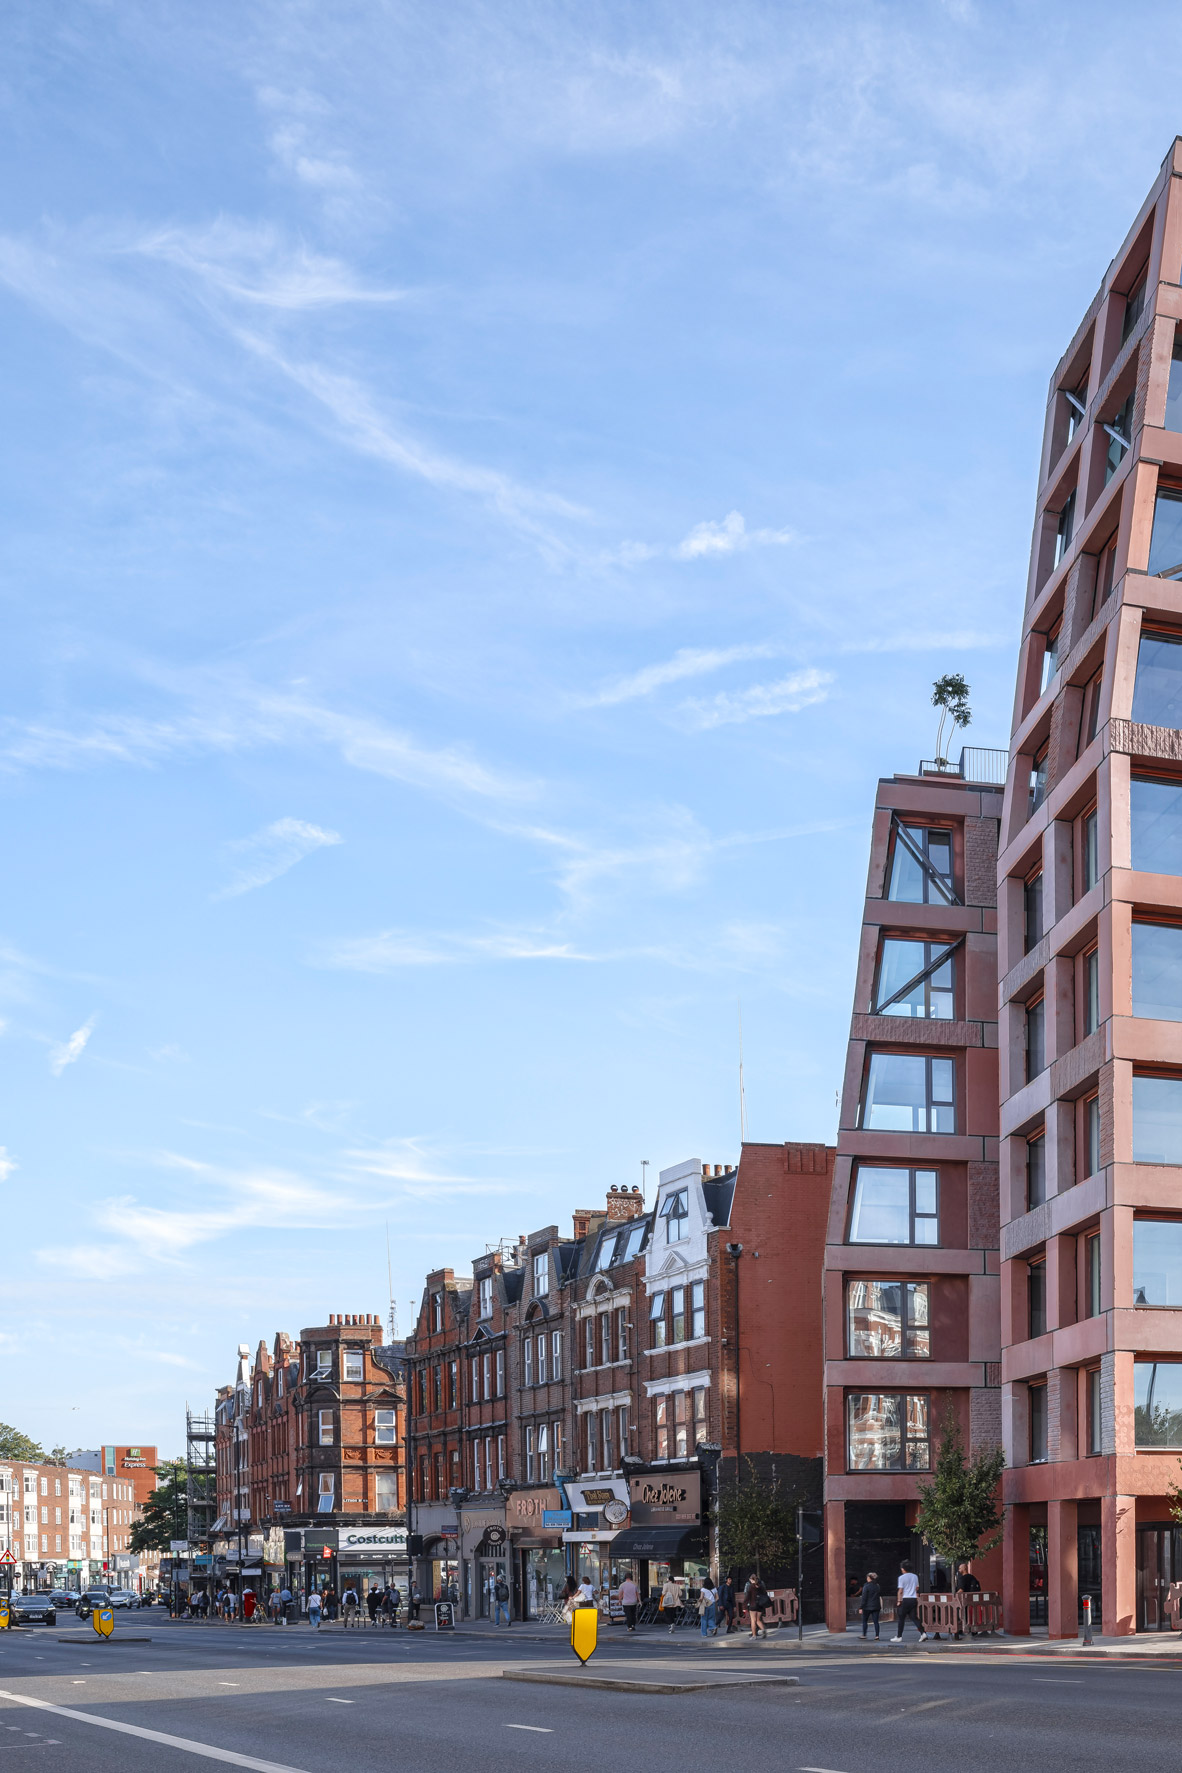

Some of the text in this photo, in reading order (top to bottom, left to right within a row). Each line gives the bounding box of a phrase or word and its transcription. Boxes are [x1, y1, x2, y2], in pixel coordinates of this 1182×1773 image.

[642, 1483, 682, 1505] Chez Jolene
[516, 1498, 547, 1516] FROTH
[347, 1534, 407, 1545] Costcutt
